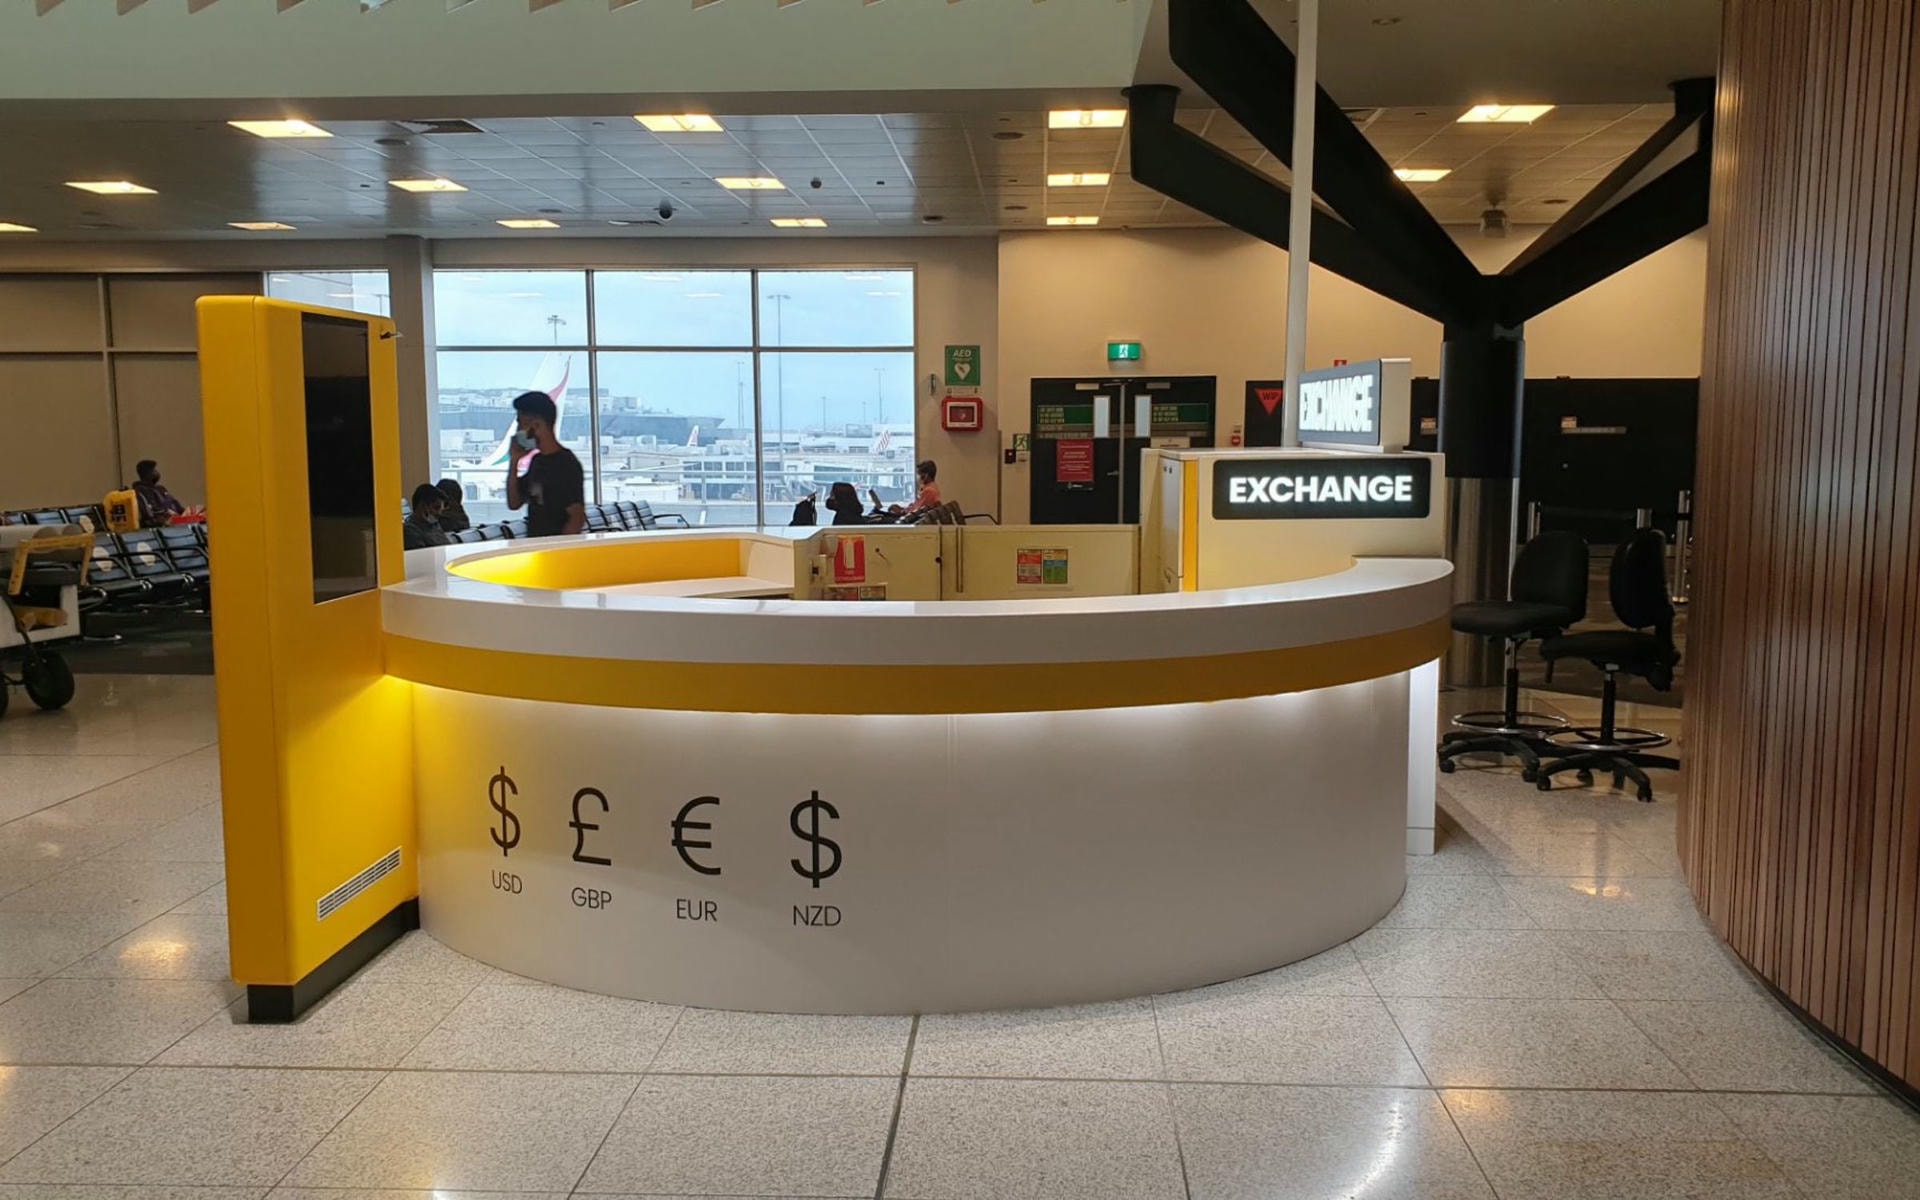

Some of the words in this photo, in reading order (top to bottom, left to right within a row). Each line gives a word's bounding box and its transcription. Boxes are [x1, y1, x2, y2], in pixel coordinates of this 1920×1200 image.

[953, 349, 972, 357] AED
[1299, 374, 1373, 432] EXCHANGE
[1229, 475, 1412, 503] EXCHANGE
[492, 869, 523, 895] USD
[571, 887, 612, 910] GBP
[676, 898, 718, 922] EUR
[792, 904, 842, 927] NZD
